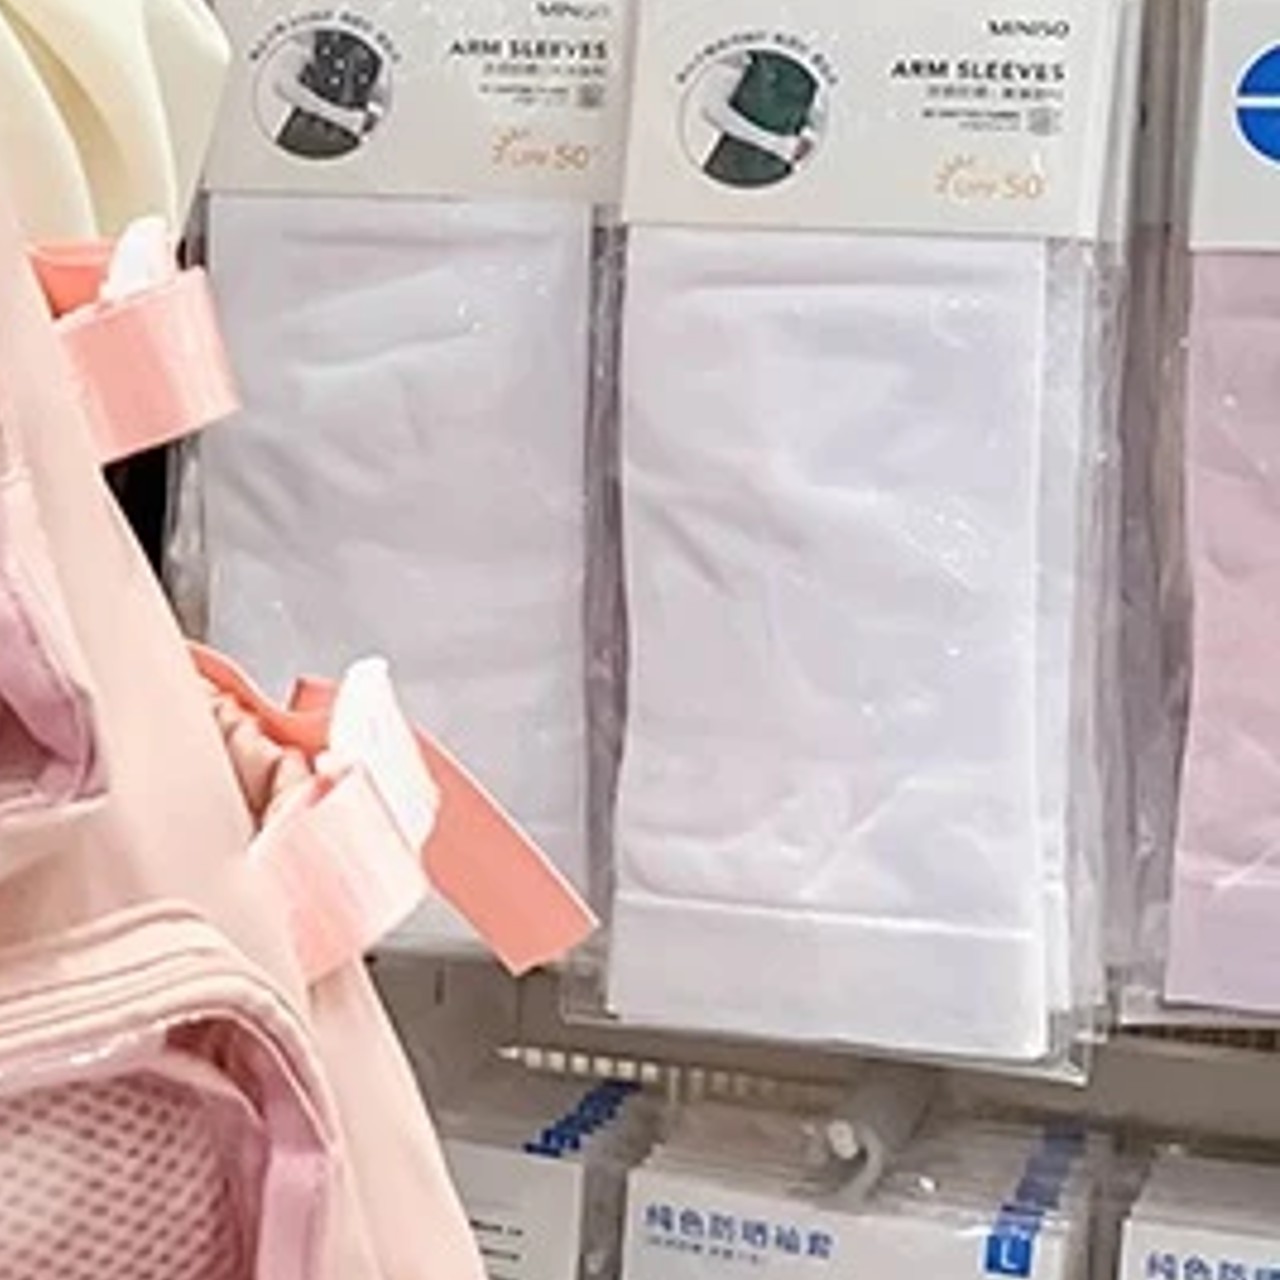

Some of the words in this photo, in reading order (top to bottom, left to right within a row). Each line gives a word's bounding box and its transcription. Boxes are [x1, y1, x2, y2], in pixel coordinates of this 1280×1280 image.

[448, 40, 501, 58] ARM
[509, 39, 608, 60] SLEEVES
[890, 59, 948, 78] ARM
[957, 60, 1065, 81] SLEEVES
